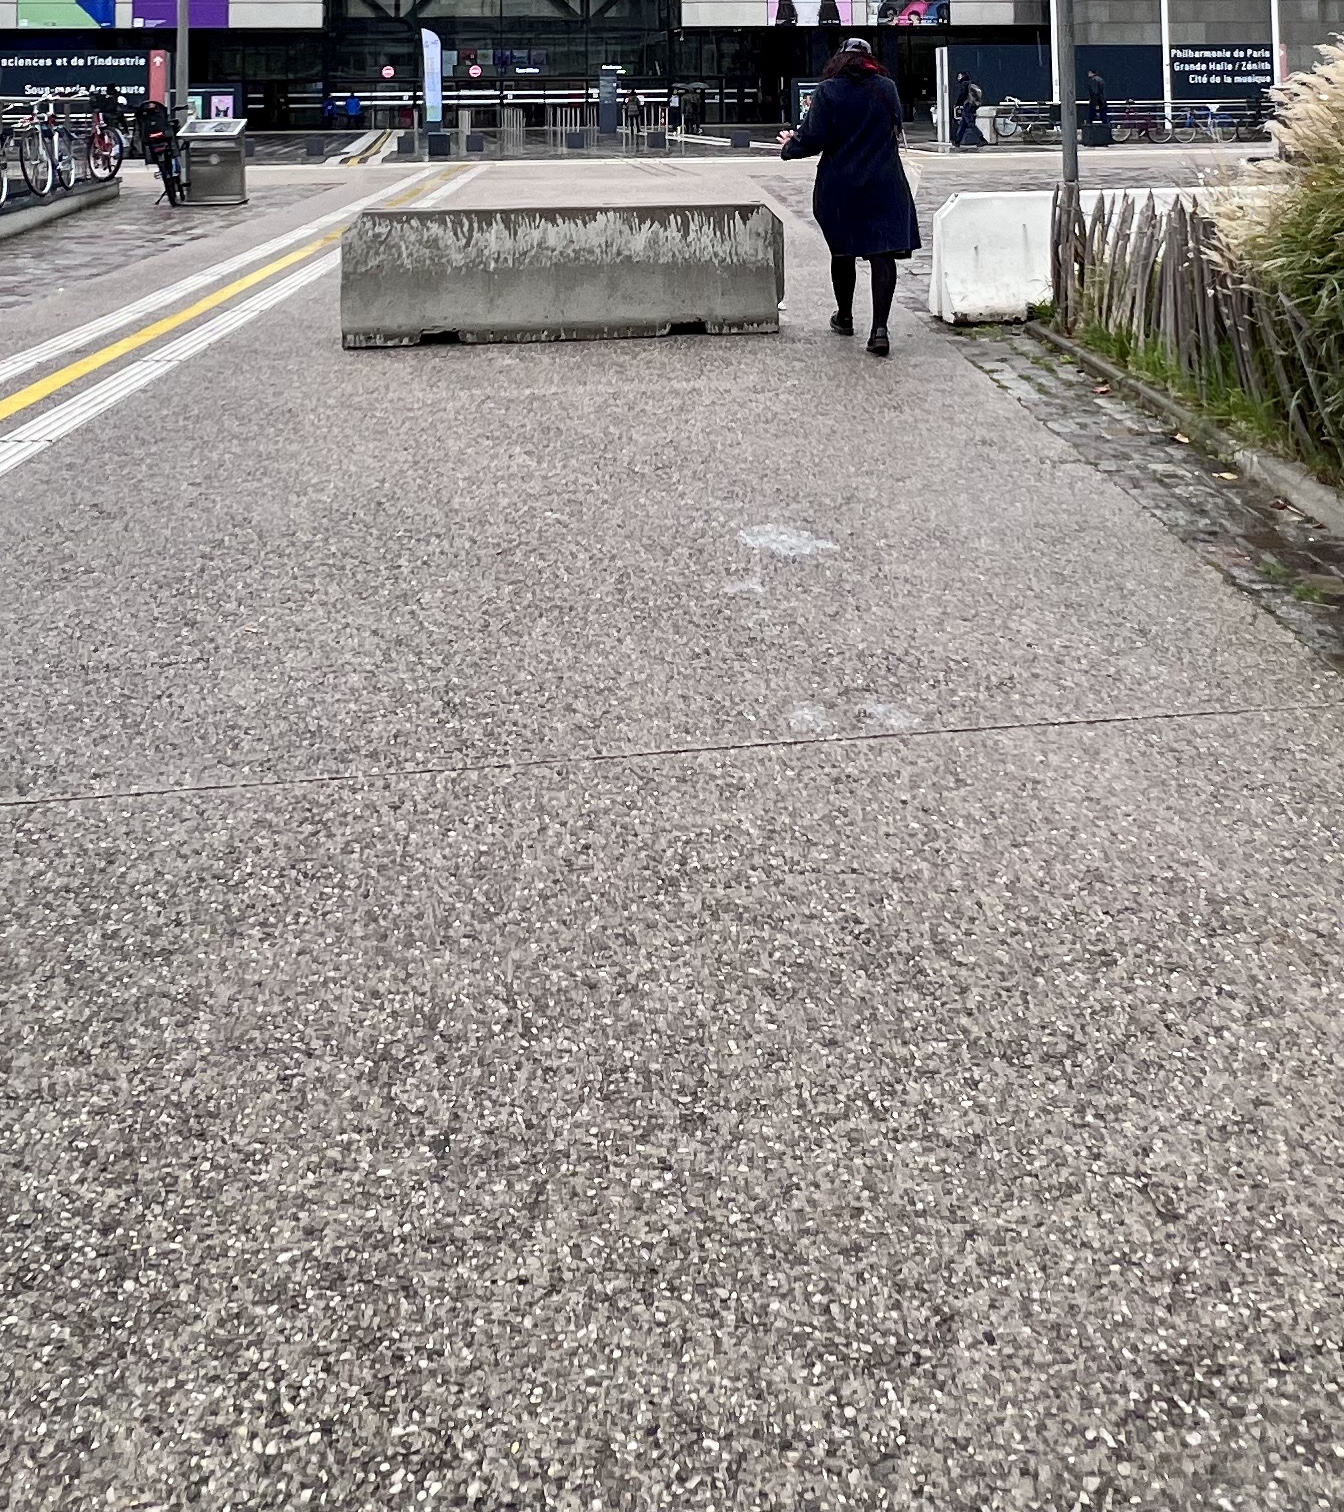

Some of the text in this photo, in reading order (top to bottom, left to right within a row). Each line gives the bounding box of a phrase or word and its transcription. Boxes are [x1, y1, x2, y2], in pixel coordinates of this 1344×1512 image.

[1170, 49, 1270, 58] Philharmonie de Paris
[1, 56, 52, 67] sciences
[55, 57, 68, 67] et
[70, 56, 85, 67] de
[87, 55, 146, 67] l'industrie
[1173, 62, 1207, 71] Grande
[1208, 62, 1233, 71] Halle
[1241, 61, 1271, 70] Zénith
[1188, 74, 1272, 85] Cité de la musique
[88, 84, 146, 95] Argaute
